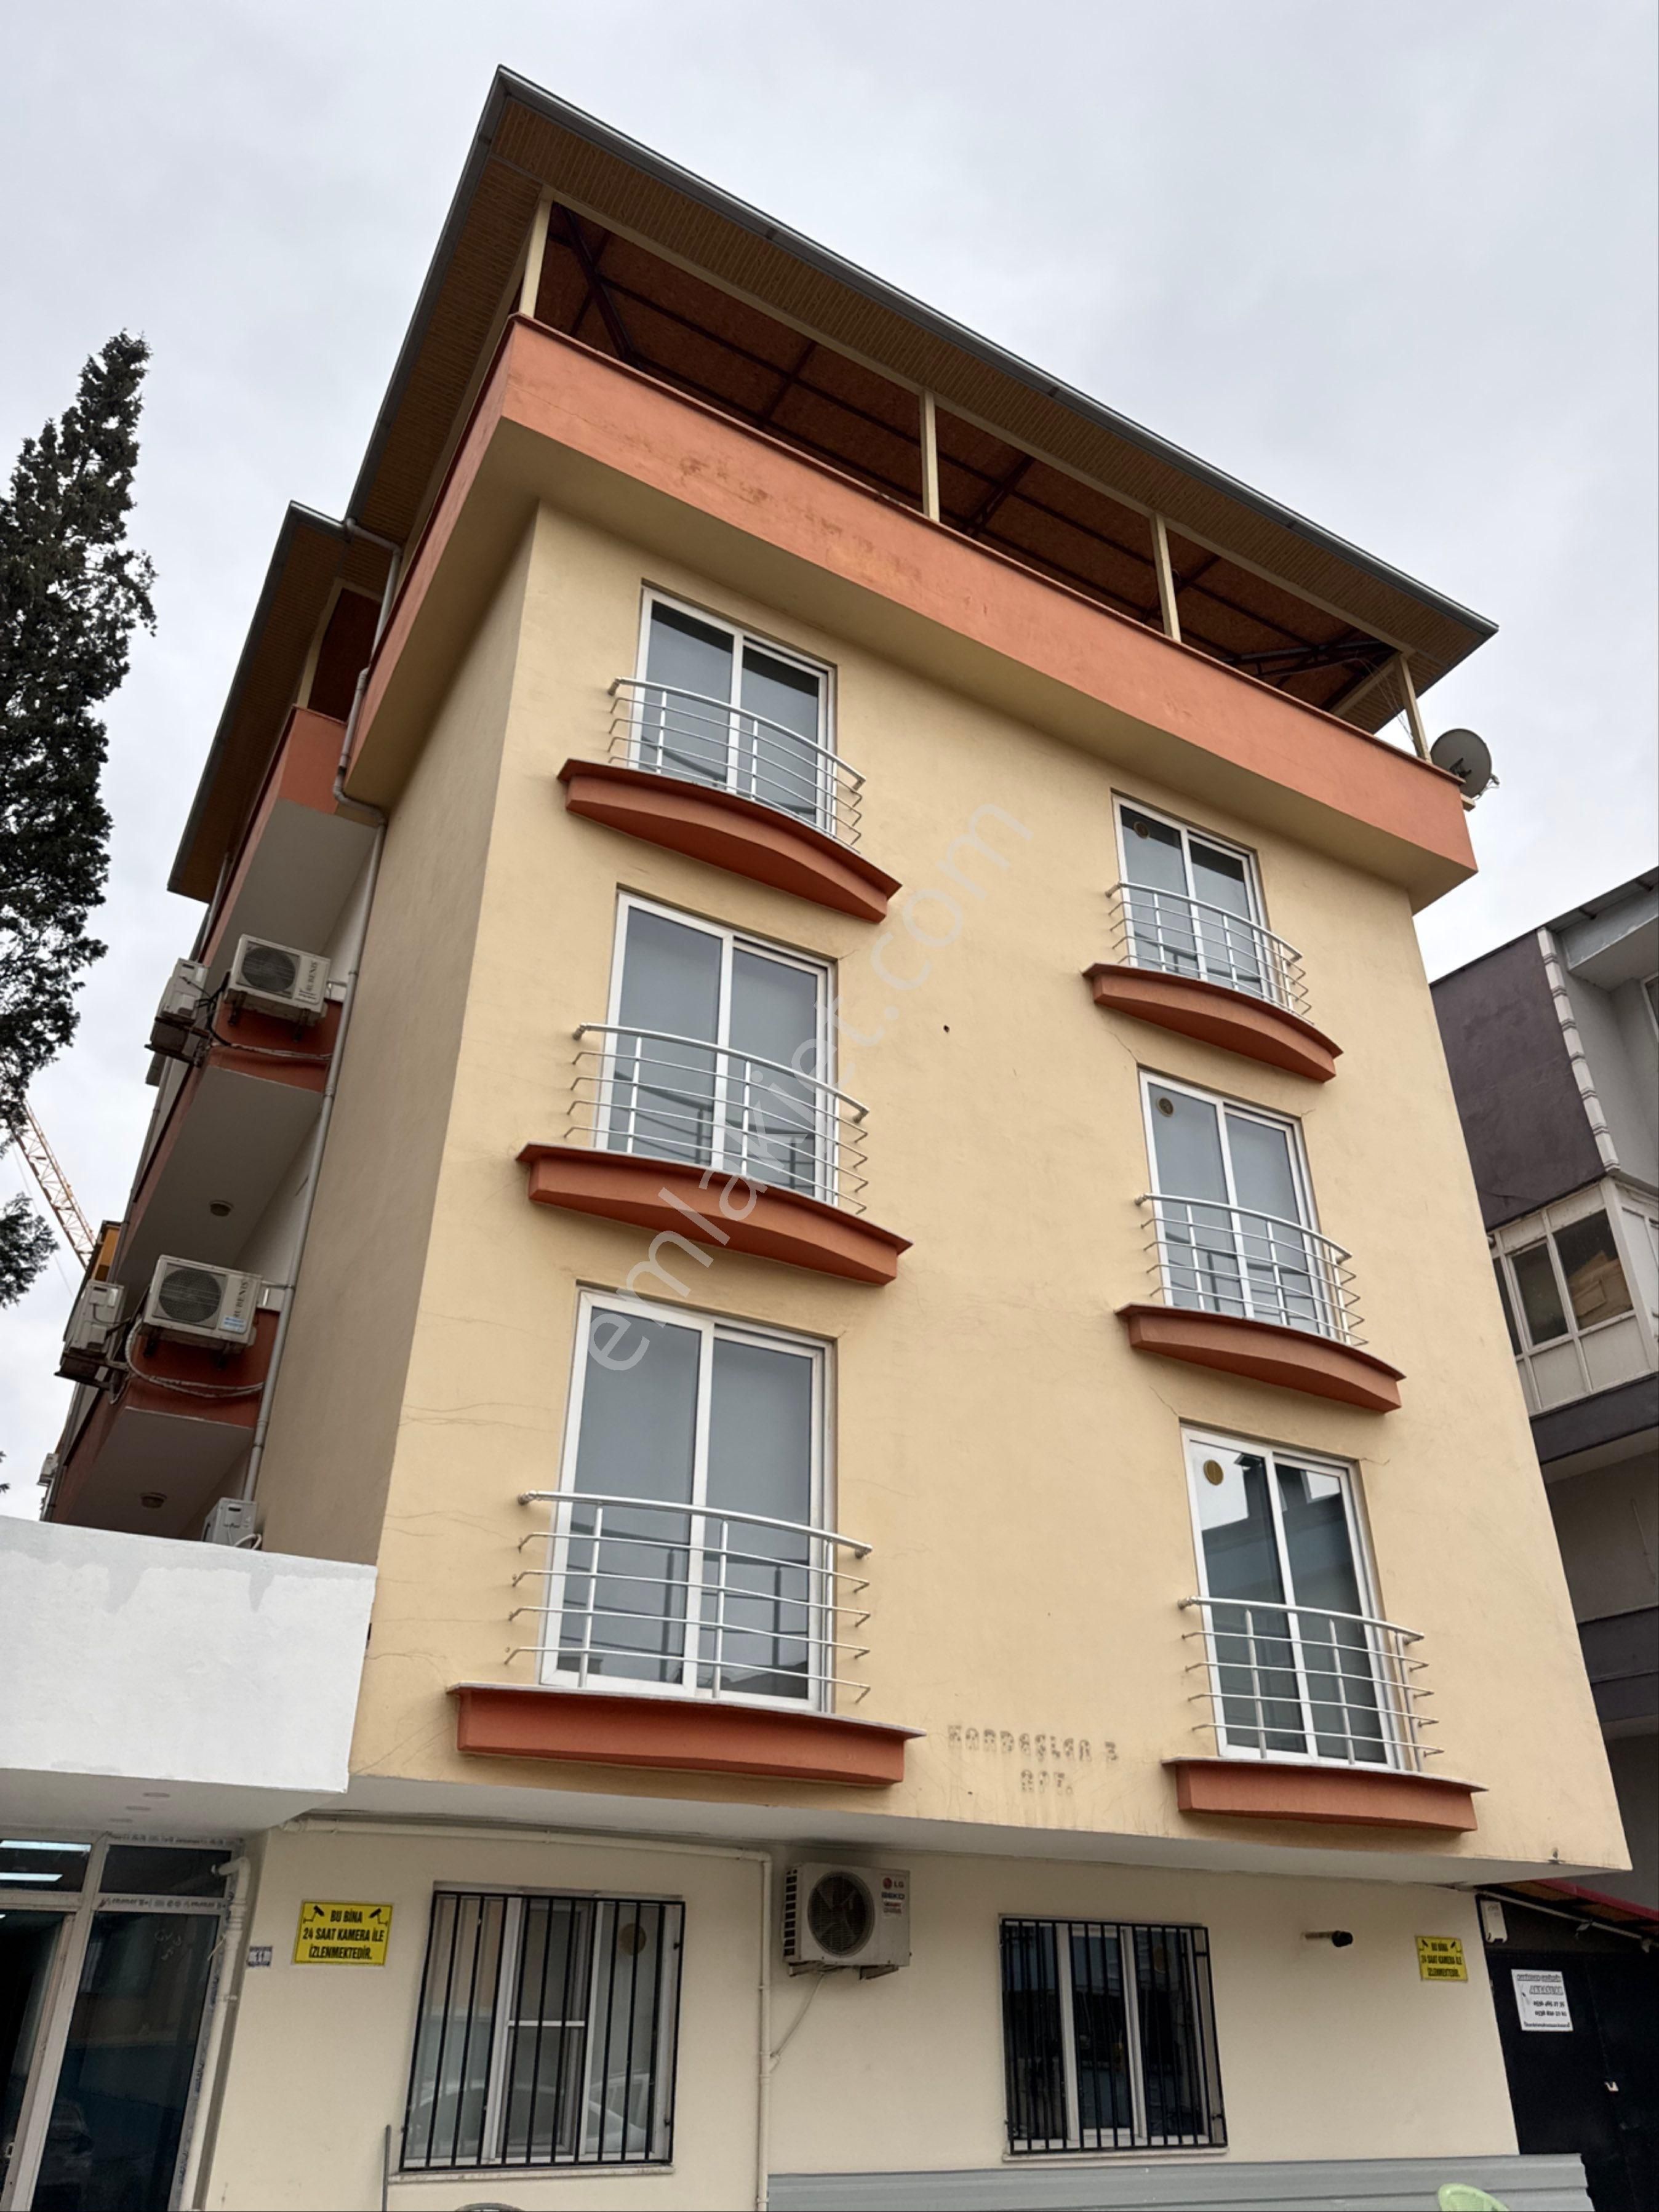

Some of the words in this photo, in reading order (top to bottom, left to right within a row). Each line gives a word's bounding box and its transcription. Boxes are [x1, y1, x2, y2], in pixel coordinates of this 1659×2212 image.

[330, 1910, 342, 1922] BU
[343, 1908, 363, 1923] BİNA
[303, 1929, 313, 1940] 24
[315, 1928, 337, 1941] SAAT
[338, 1929, 370, 1942] KAMERA
[372, 1927, 384, 1942] İLE
